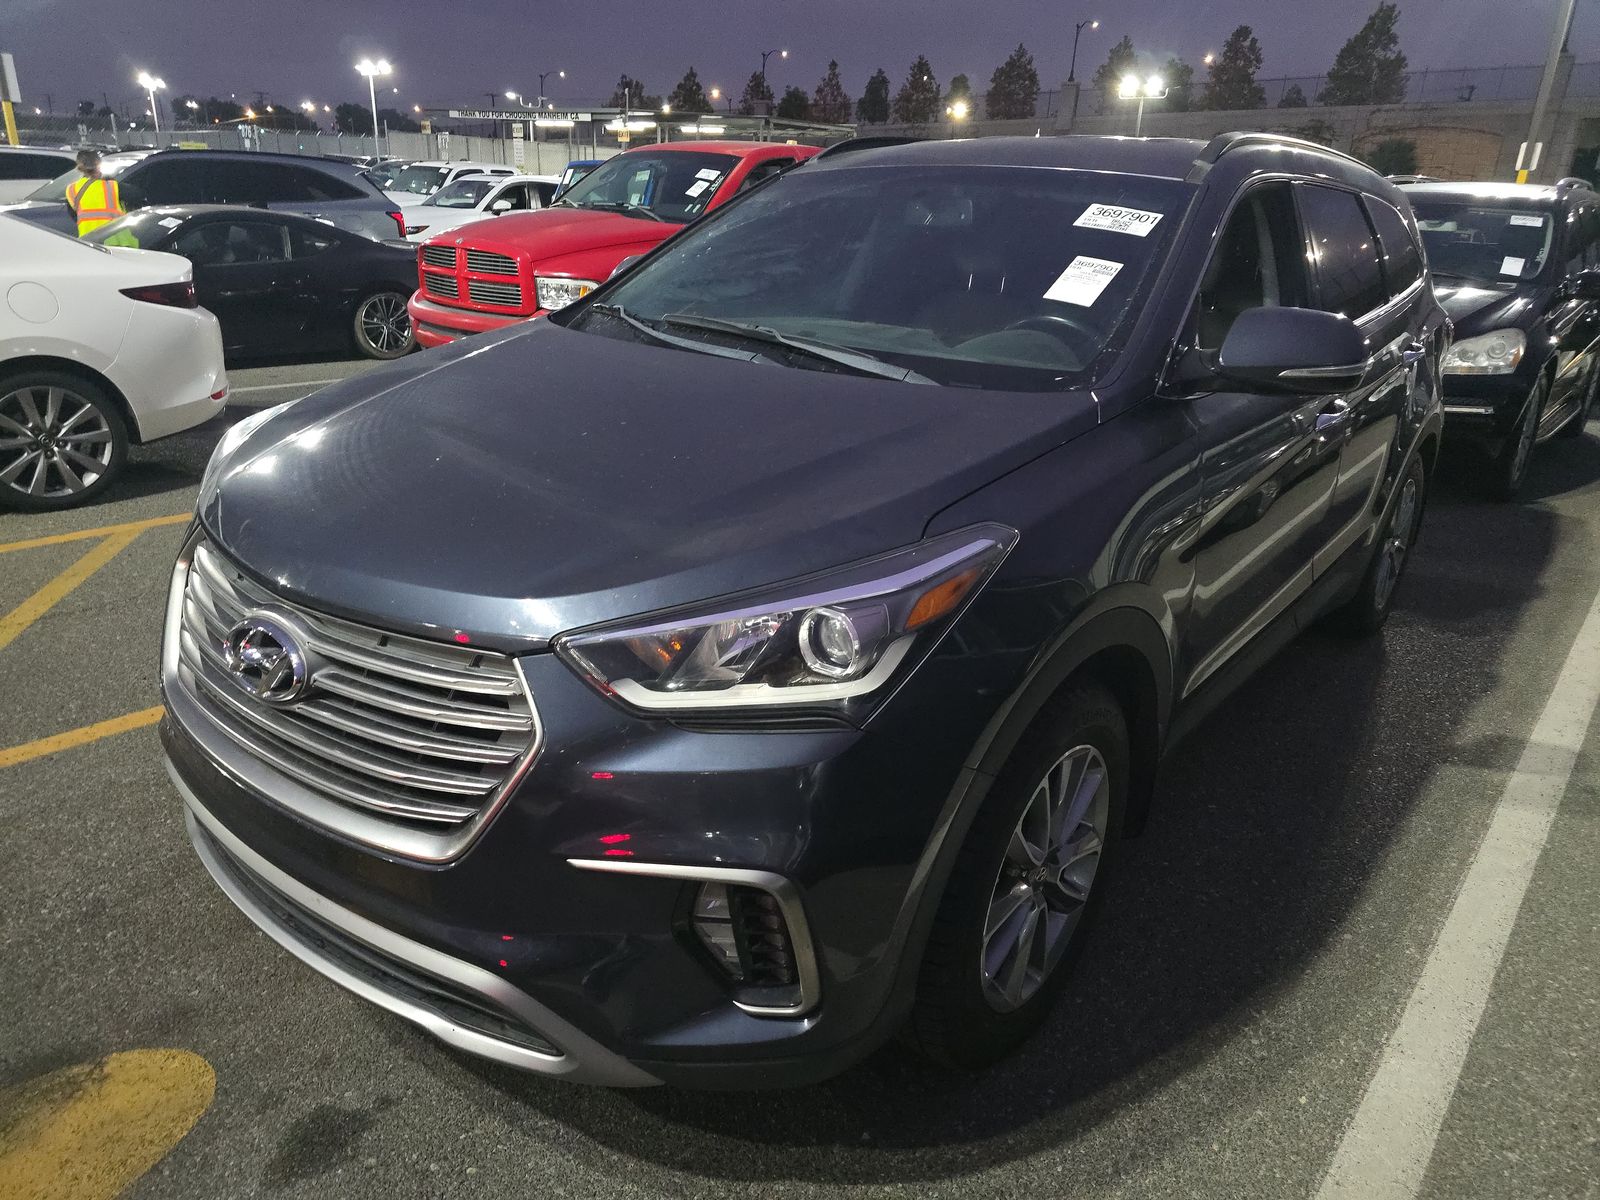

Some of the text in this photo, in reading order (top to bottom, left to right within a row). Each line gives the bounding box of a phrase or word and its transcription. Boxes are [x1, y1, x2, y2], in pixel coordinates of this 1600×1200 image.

[478, 110, 490, 118] YOU
[492, 110, 504, 118] FOR
[505, 111, 536, 119] CHOOSING
[538, 111, 569, 119] MANHEIM
[570, 112, 580, 120] CA
[1092, 207, 1158, 225] 3697901
[1074, 260, 1119, 273] 3697901
